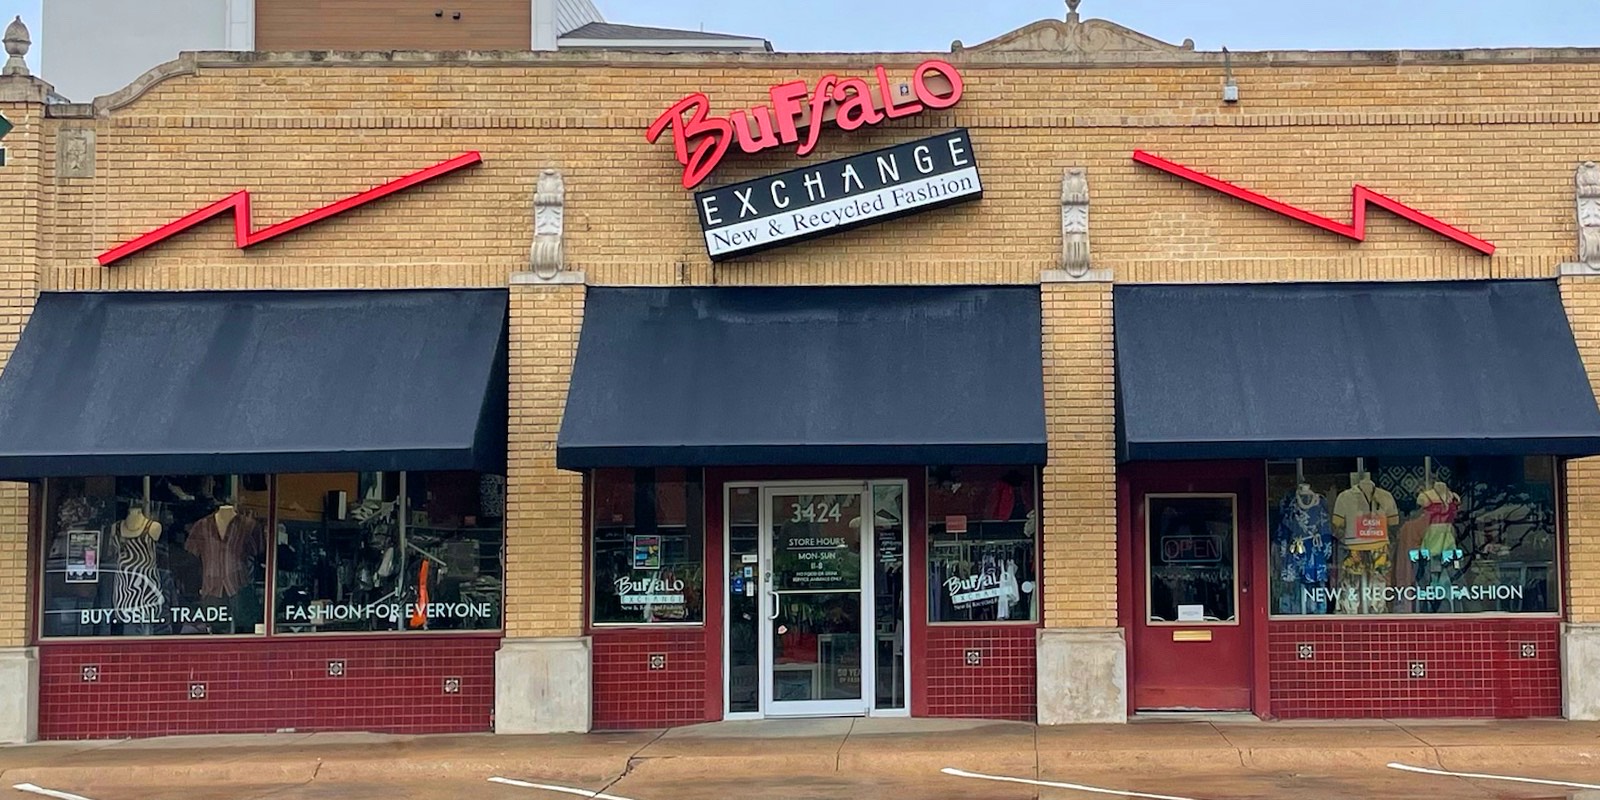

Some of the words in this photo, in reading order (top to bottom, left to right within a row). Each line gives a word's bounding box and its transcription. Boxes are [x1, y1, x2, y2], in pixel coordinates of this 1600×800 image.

[700, 137, 969, 226] EXCHANGE
[712, 229, 759, 250] New
[767, 218, 785, 237] &
[792, 196, 886, 228] Recycled
[891, 176, 974, 208] Fashion
[791, 502, 842, 523] 3424
[789, 538, 815, 546] STORE
[816, 537, 846, 546] HOURS
[1164, 539, 1218, 558] OPEN
[798, 552, 836, 560] MON-SUN
[1303, 587, 1342, 602] NEW
[1347, 587, 1359, 601] &
[1362, 586, 1446, 601] RECYCLED
[1450, 585, 1523, 600] FASHION
[80, 608, 117, 625] BUY.
[123, 608, 166, 624] SELL.
[170, 606, 233, 623] TRADE.
[285, 604, 361, 620] FASHION
[366, 603, 400, 619] FOR
[405, 602, 491, 618] EVERYONE
